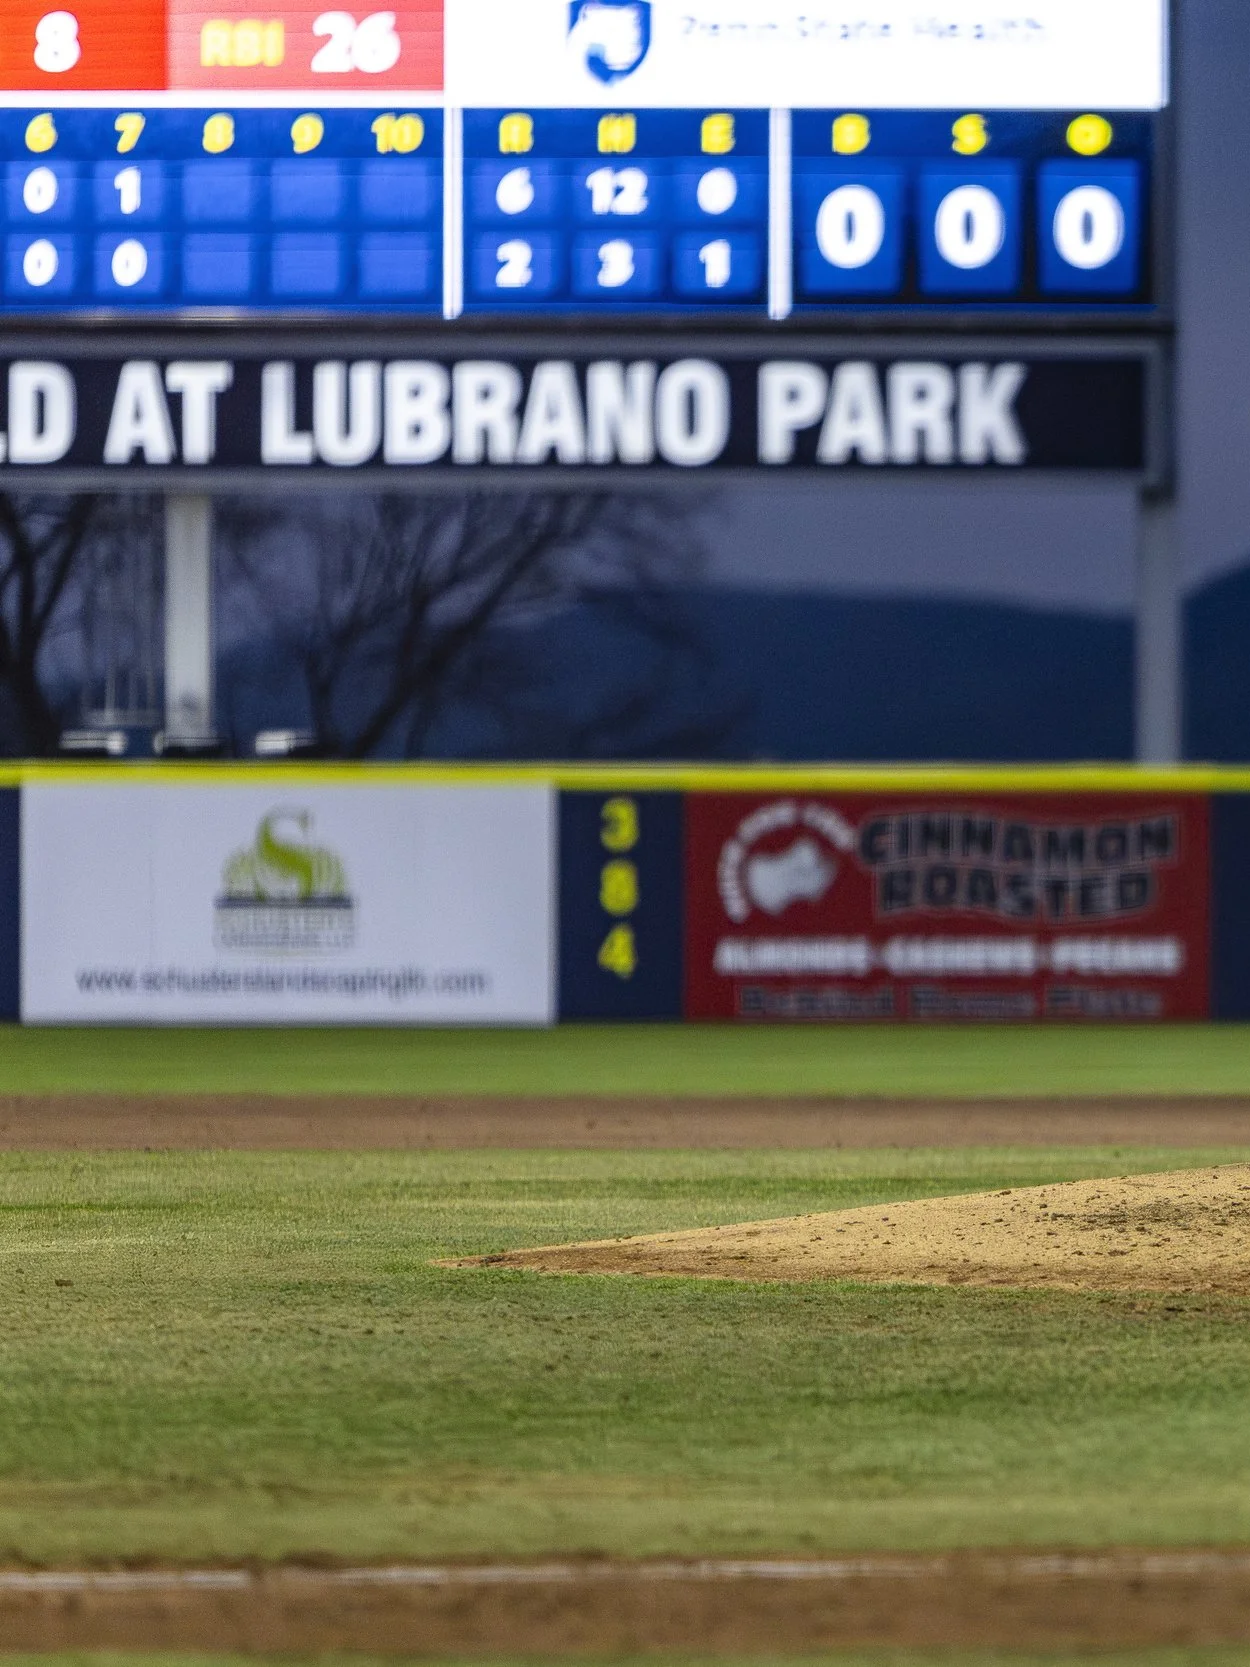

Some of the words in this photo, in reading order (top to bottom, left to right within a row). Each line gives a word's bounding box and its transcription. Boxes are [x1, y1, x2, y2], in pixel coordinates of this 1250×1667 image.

[34, 11, 80, 73] 8
[199, 19, 285, 67] RBI
[311, 11, 400, 73] 26
[114, 113, 146, 153] 7
[202, 113, 235, 153] 8
[290, 113, 324, 153] 9
[370, 113, 425, 153] 10
[951, 113, 989, 155] S
[23, 166, 58, 214] 0
[113, 167, 141, 214] 1
[495, 168, 534, 215] 6
[585, 168, 648, 215] 12
[697, 168, 737, 214] 0
[815, 185, 884, 269] 0
[934, 185, 1004, 269] 0
[1053, 185, 1124, 269] 0
[23, 239, 58, 286] 0
[111, 239, 148, 286] 0
[495, 240, 532, 287] 2
[597, 240, 635, 287] 3
[699, 240, 731, 287] 1
[0, 360, 77, 465] D
[103, 360, 234, 465] AT
[260, 358, 731, 467] LUBRANO
[757, 360, 1027, 465] PARK
[858, 812, 1177, 865] CINNAMON
[878, 864, 1152, 920] ROASTED
